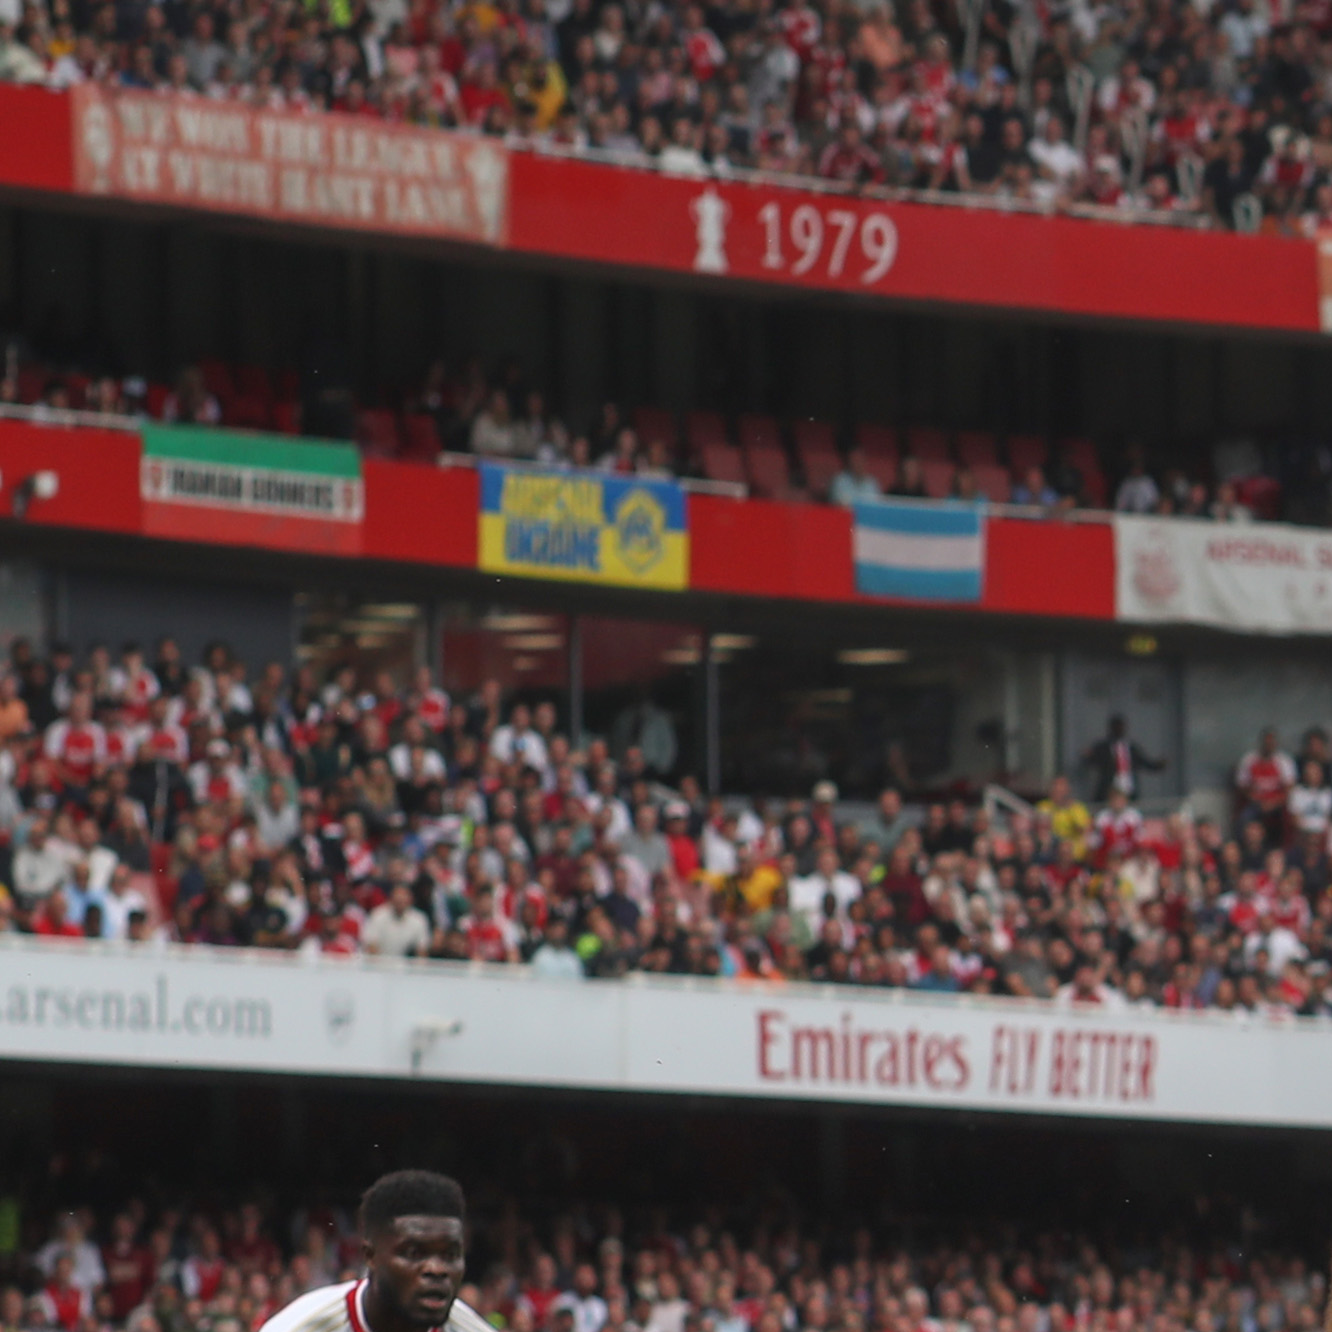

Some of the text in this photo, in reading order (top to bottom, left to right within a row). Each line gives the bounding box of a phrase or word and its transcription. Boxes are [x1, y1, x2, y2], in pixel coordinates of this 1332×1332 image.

[756, 201, 899, 286] 1979
[1206, 538, 1306, 571] ARSENAL
[755, 1008, 1159, 1101] Emirates FLY BETTER
